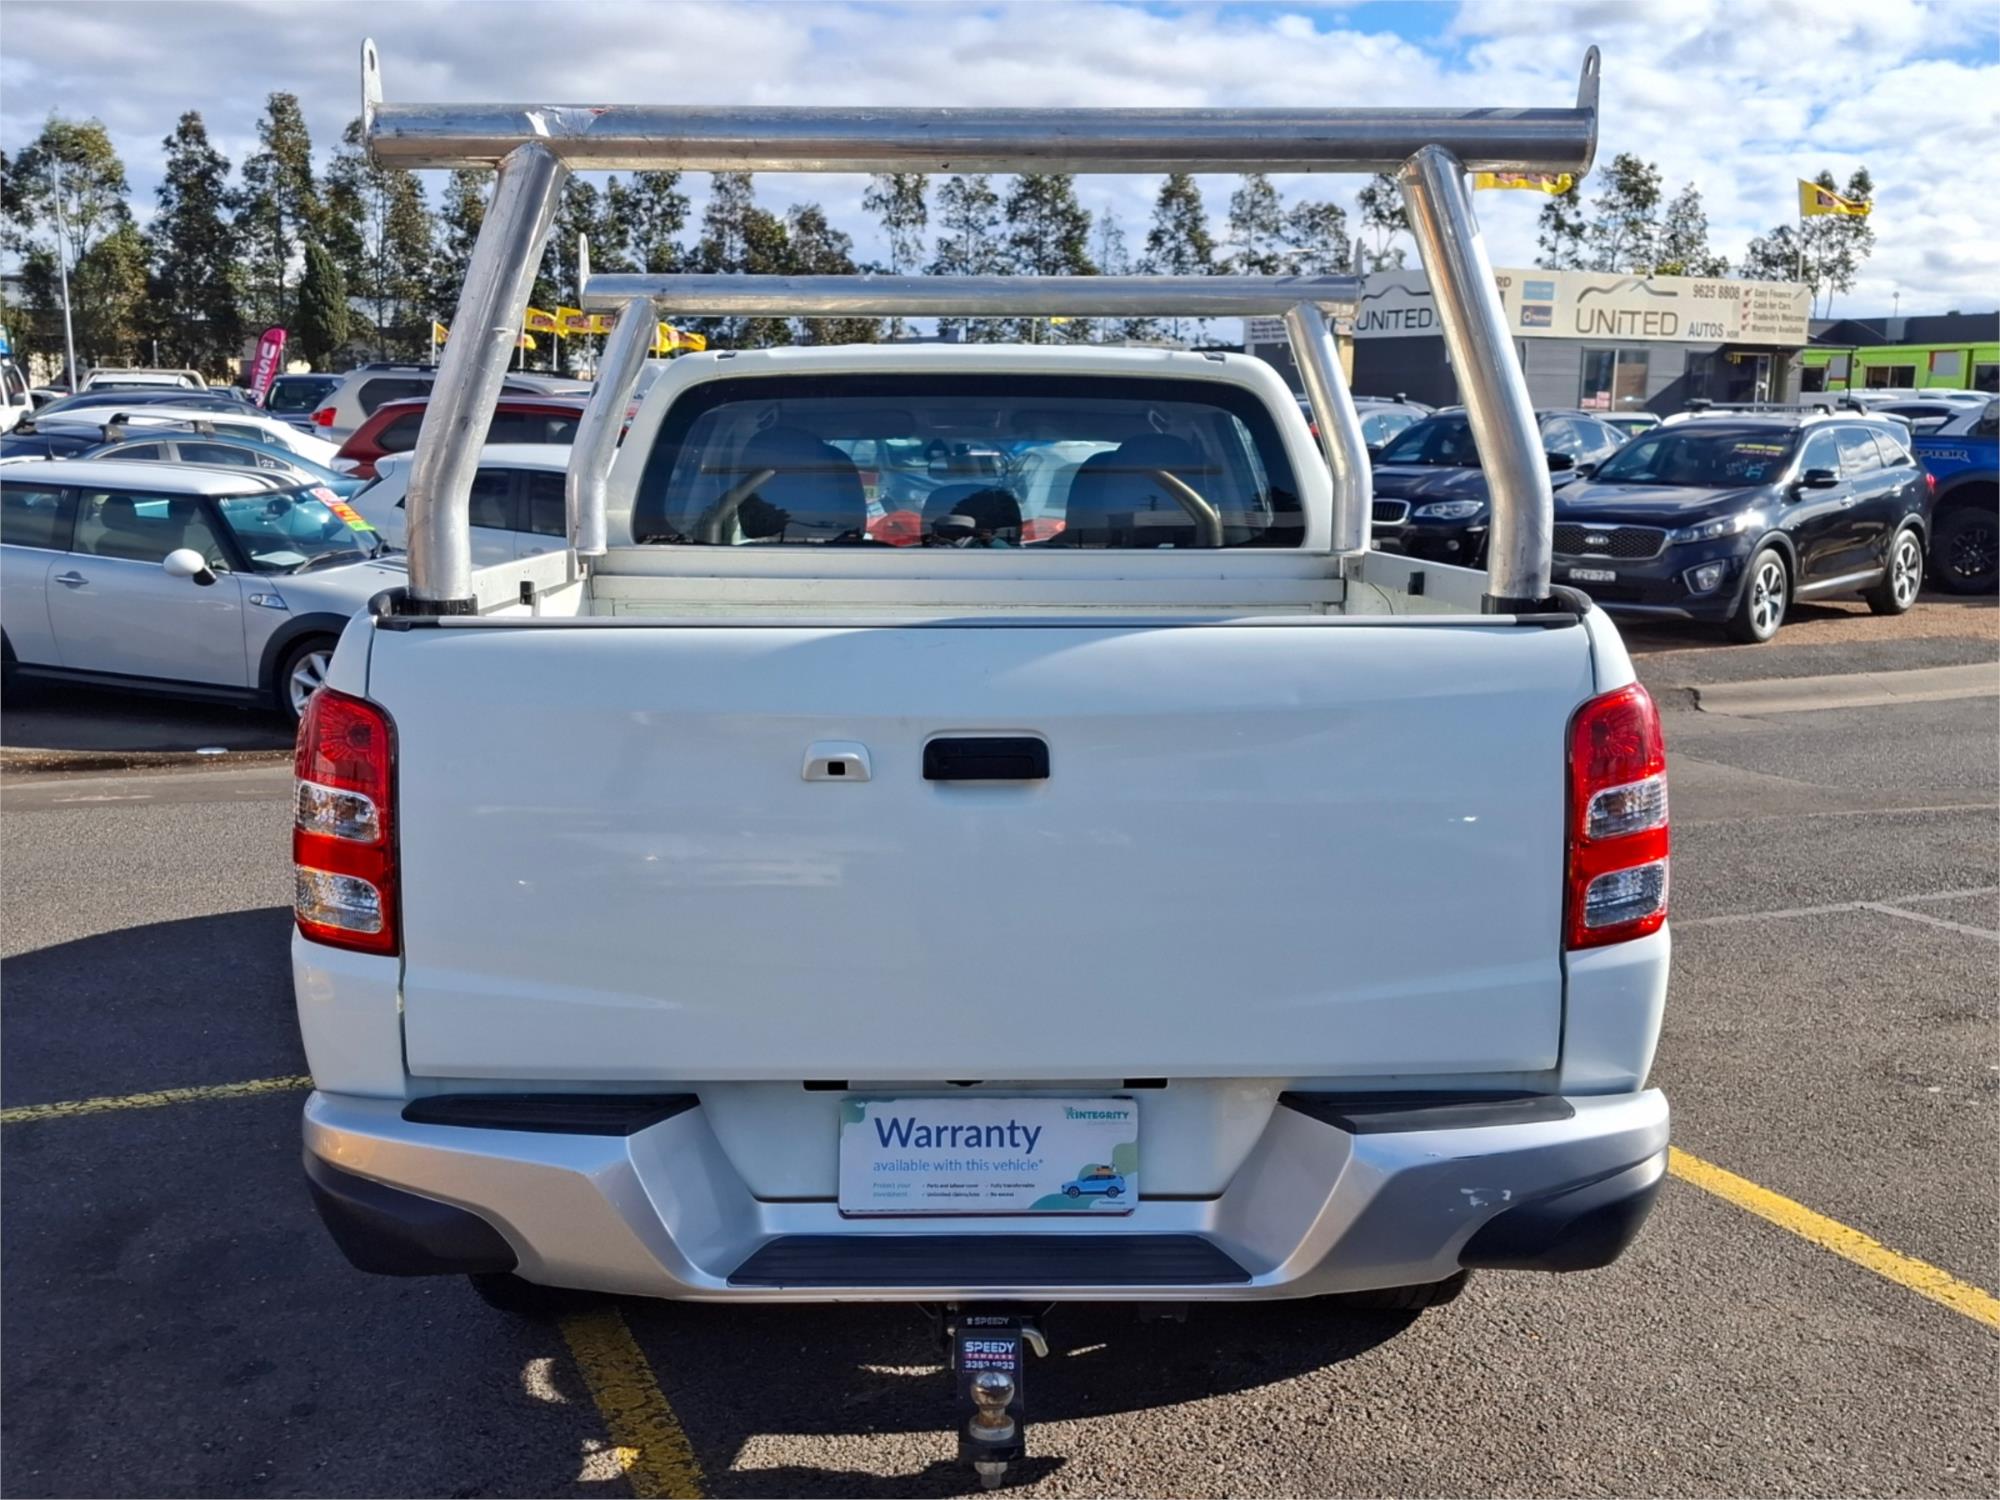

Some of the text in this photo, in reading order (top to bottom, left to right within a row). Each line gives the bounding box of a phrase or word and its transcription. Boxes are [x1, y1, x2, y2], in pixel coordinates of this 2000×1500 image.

[1693, 284, 1740, 300] 9625 8808
[1754, 288, 1793, 299] Easy Finance
[1753, 300, 1768, 310] Cash
[1778, 302, 1792, 311] Cars
[1356, 308, 1433, 331] UNITED
[1576, 308, 1679, 336] UNITED
[1781, 312, 1806, 323] Welcome
[1688, 322, 1725, 338] AUTOS
[1751, 323, 1804, 334] Warranty Available
[1075, 1110, 1130, 1120] INTEGRITY
[873, 1117, 1043, 1154] Warranty
[873, 1158, 930, 1172] available
[933, 1158, 962, 1172] with
[965, 1158, 989, 1172] this
[974, 1316, 1009, 1325] SPEEDY
[965, 1341, 1015, 1353] SPEEDY
